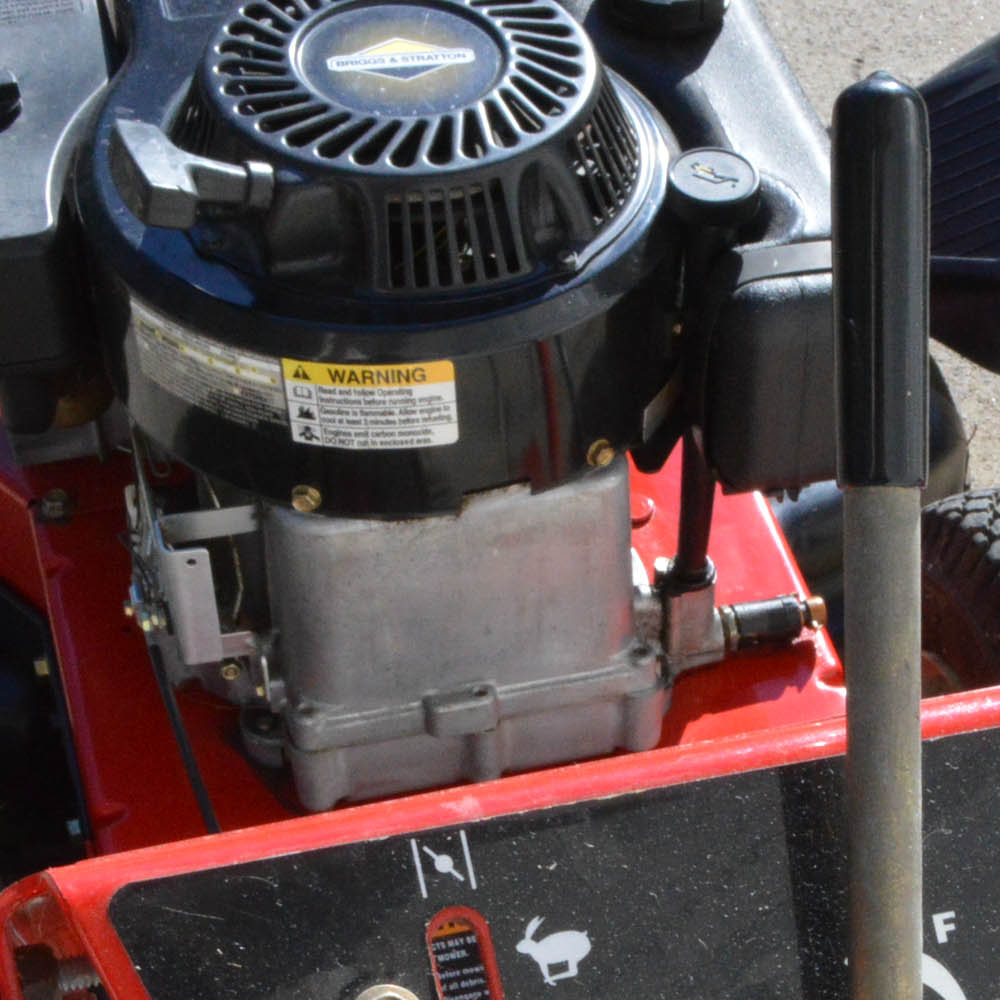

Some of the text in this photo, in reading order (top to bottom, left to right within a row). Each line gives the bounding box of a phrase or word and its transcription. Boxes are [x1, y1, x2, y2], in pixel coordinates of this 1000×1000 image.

[335, 58, 386, 68] BRIGGS
[400, 52, 467, 64] STRATTON
[326, 367, 427, 384] WARNING
[931, 910, 956, 944] F
[447, 937, 464, 948] MAY
[437, 950, 469, 962] MOWER.
